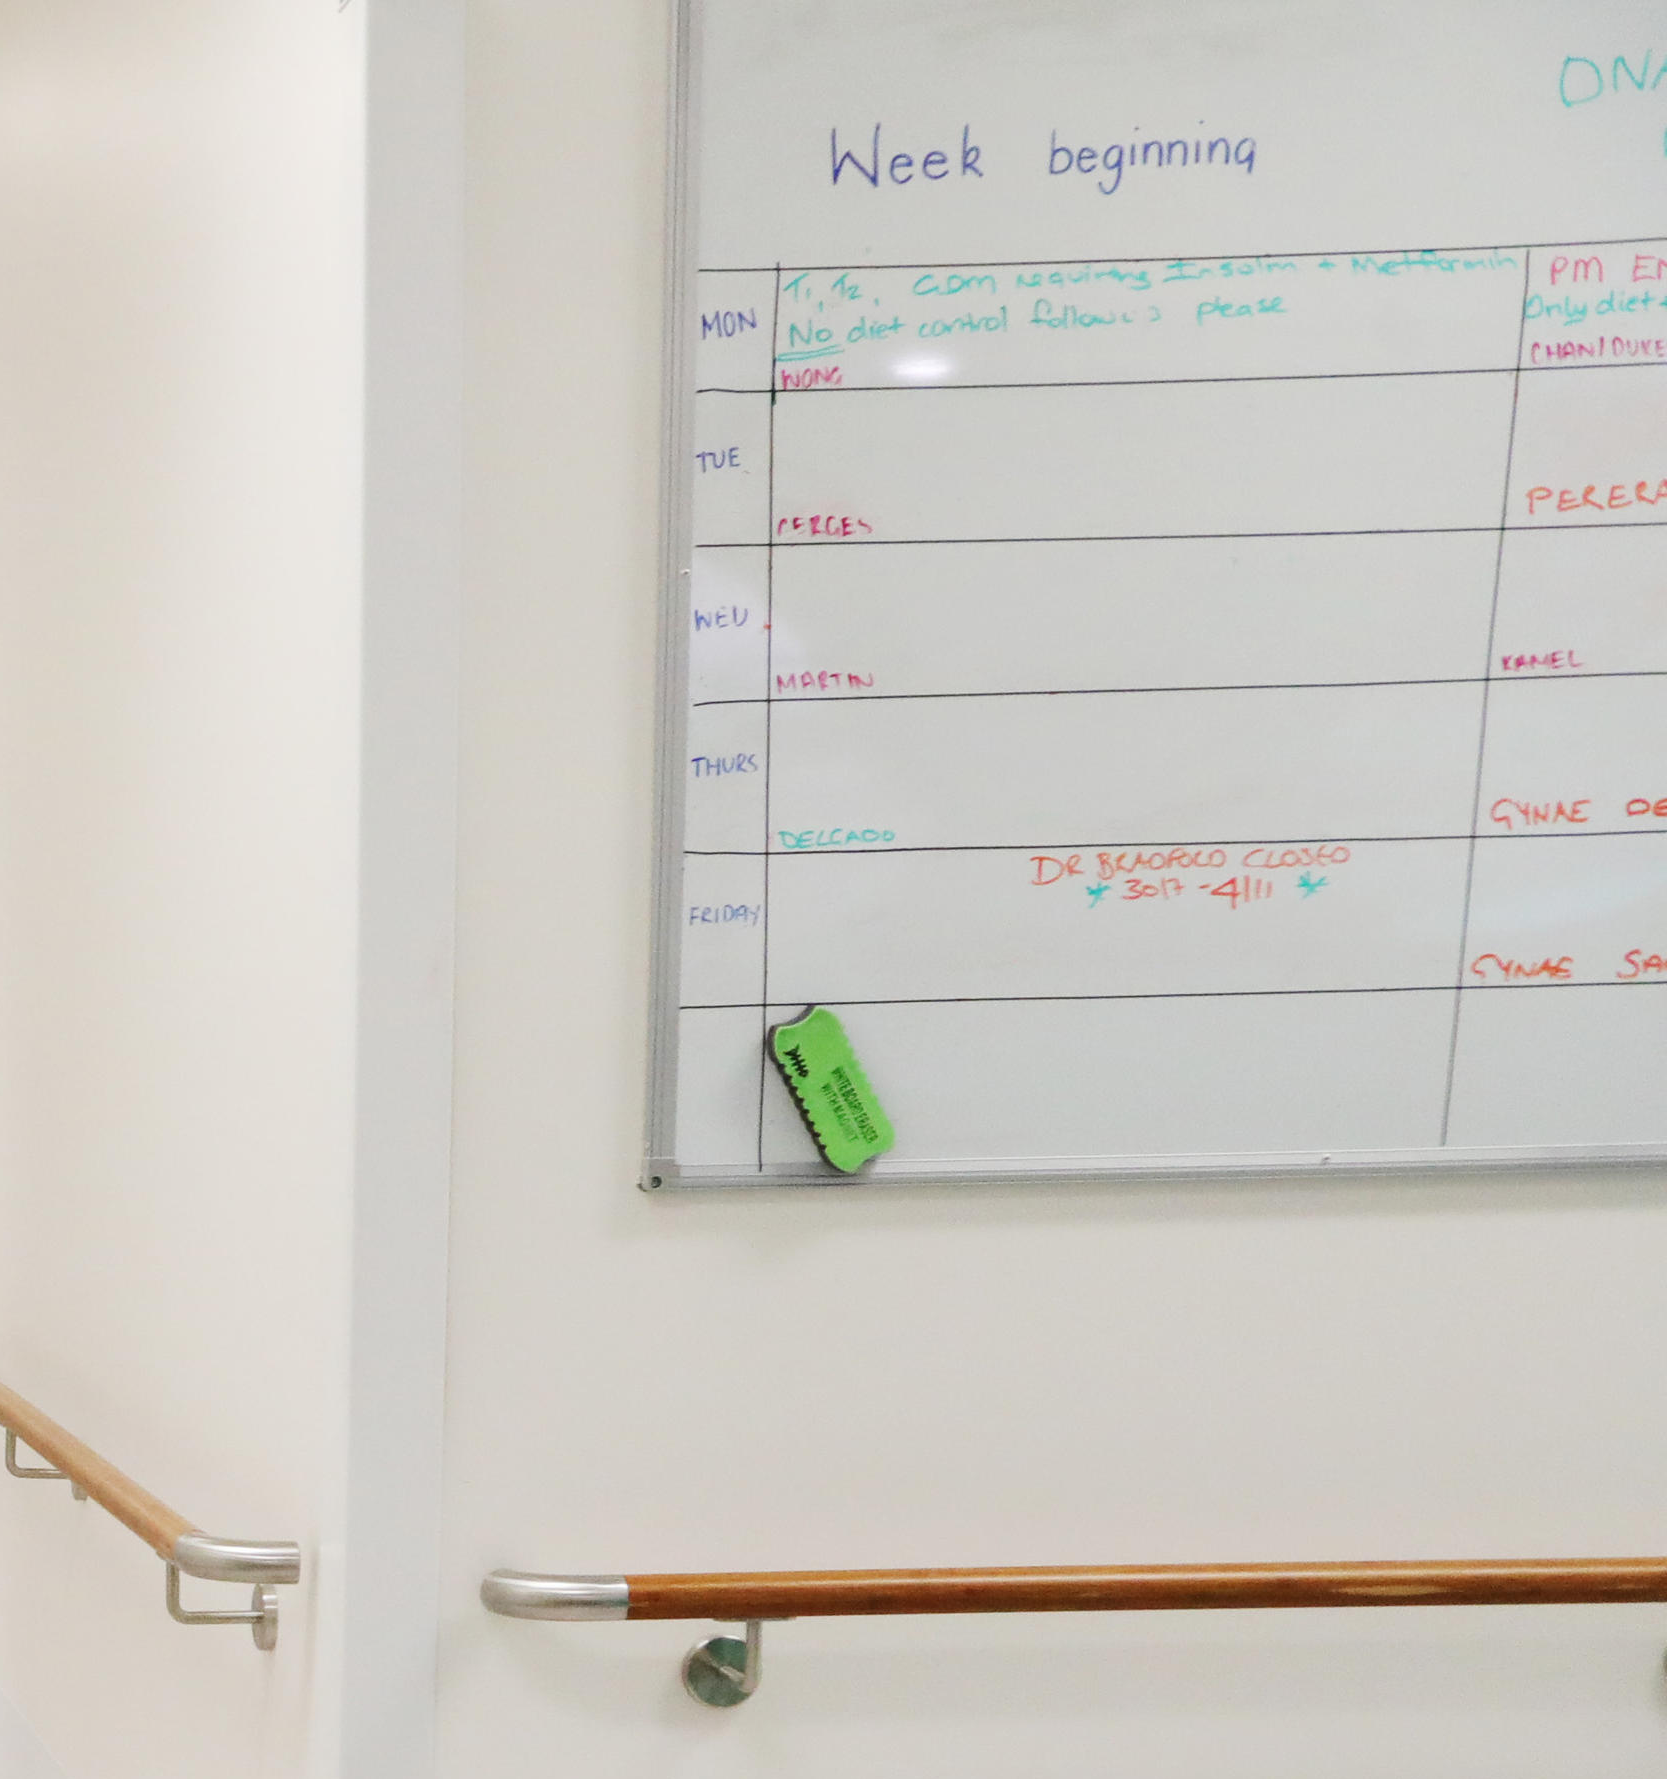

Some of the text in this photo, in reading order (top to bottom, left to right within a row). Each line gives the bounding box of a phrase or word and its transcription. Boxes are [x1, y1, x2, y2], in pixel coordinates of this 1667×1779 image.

[831, 122, 984, 188] Week
[1550, 255, 1604, 285] PM
[701, 308, 758, 340] MON
[1197, 296, 1287, 325] please
[695, 446, 742, 473] TUE
[691, 753, 759, 778] THURS
[689, 904, 761, 926] FRIDAY
